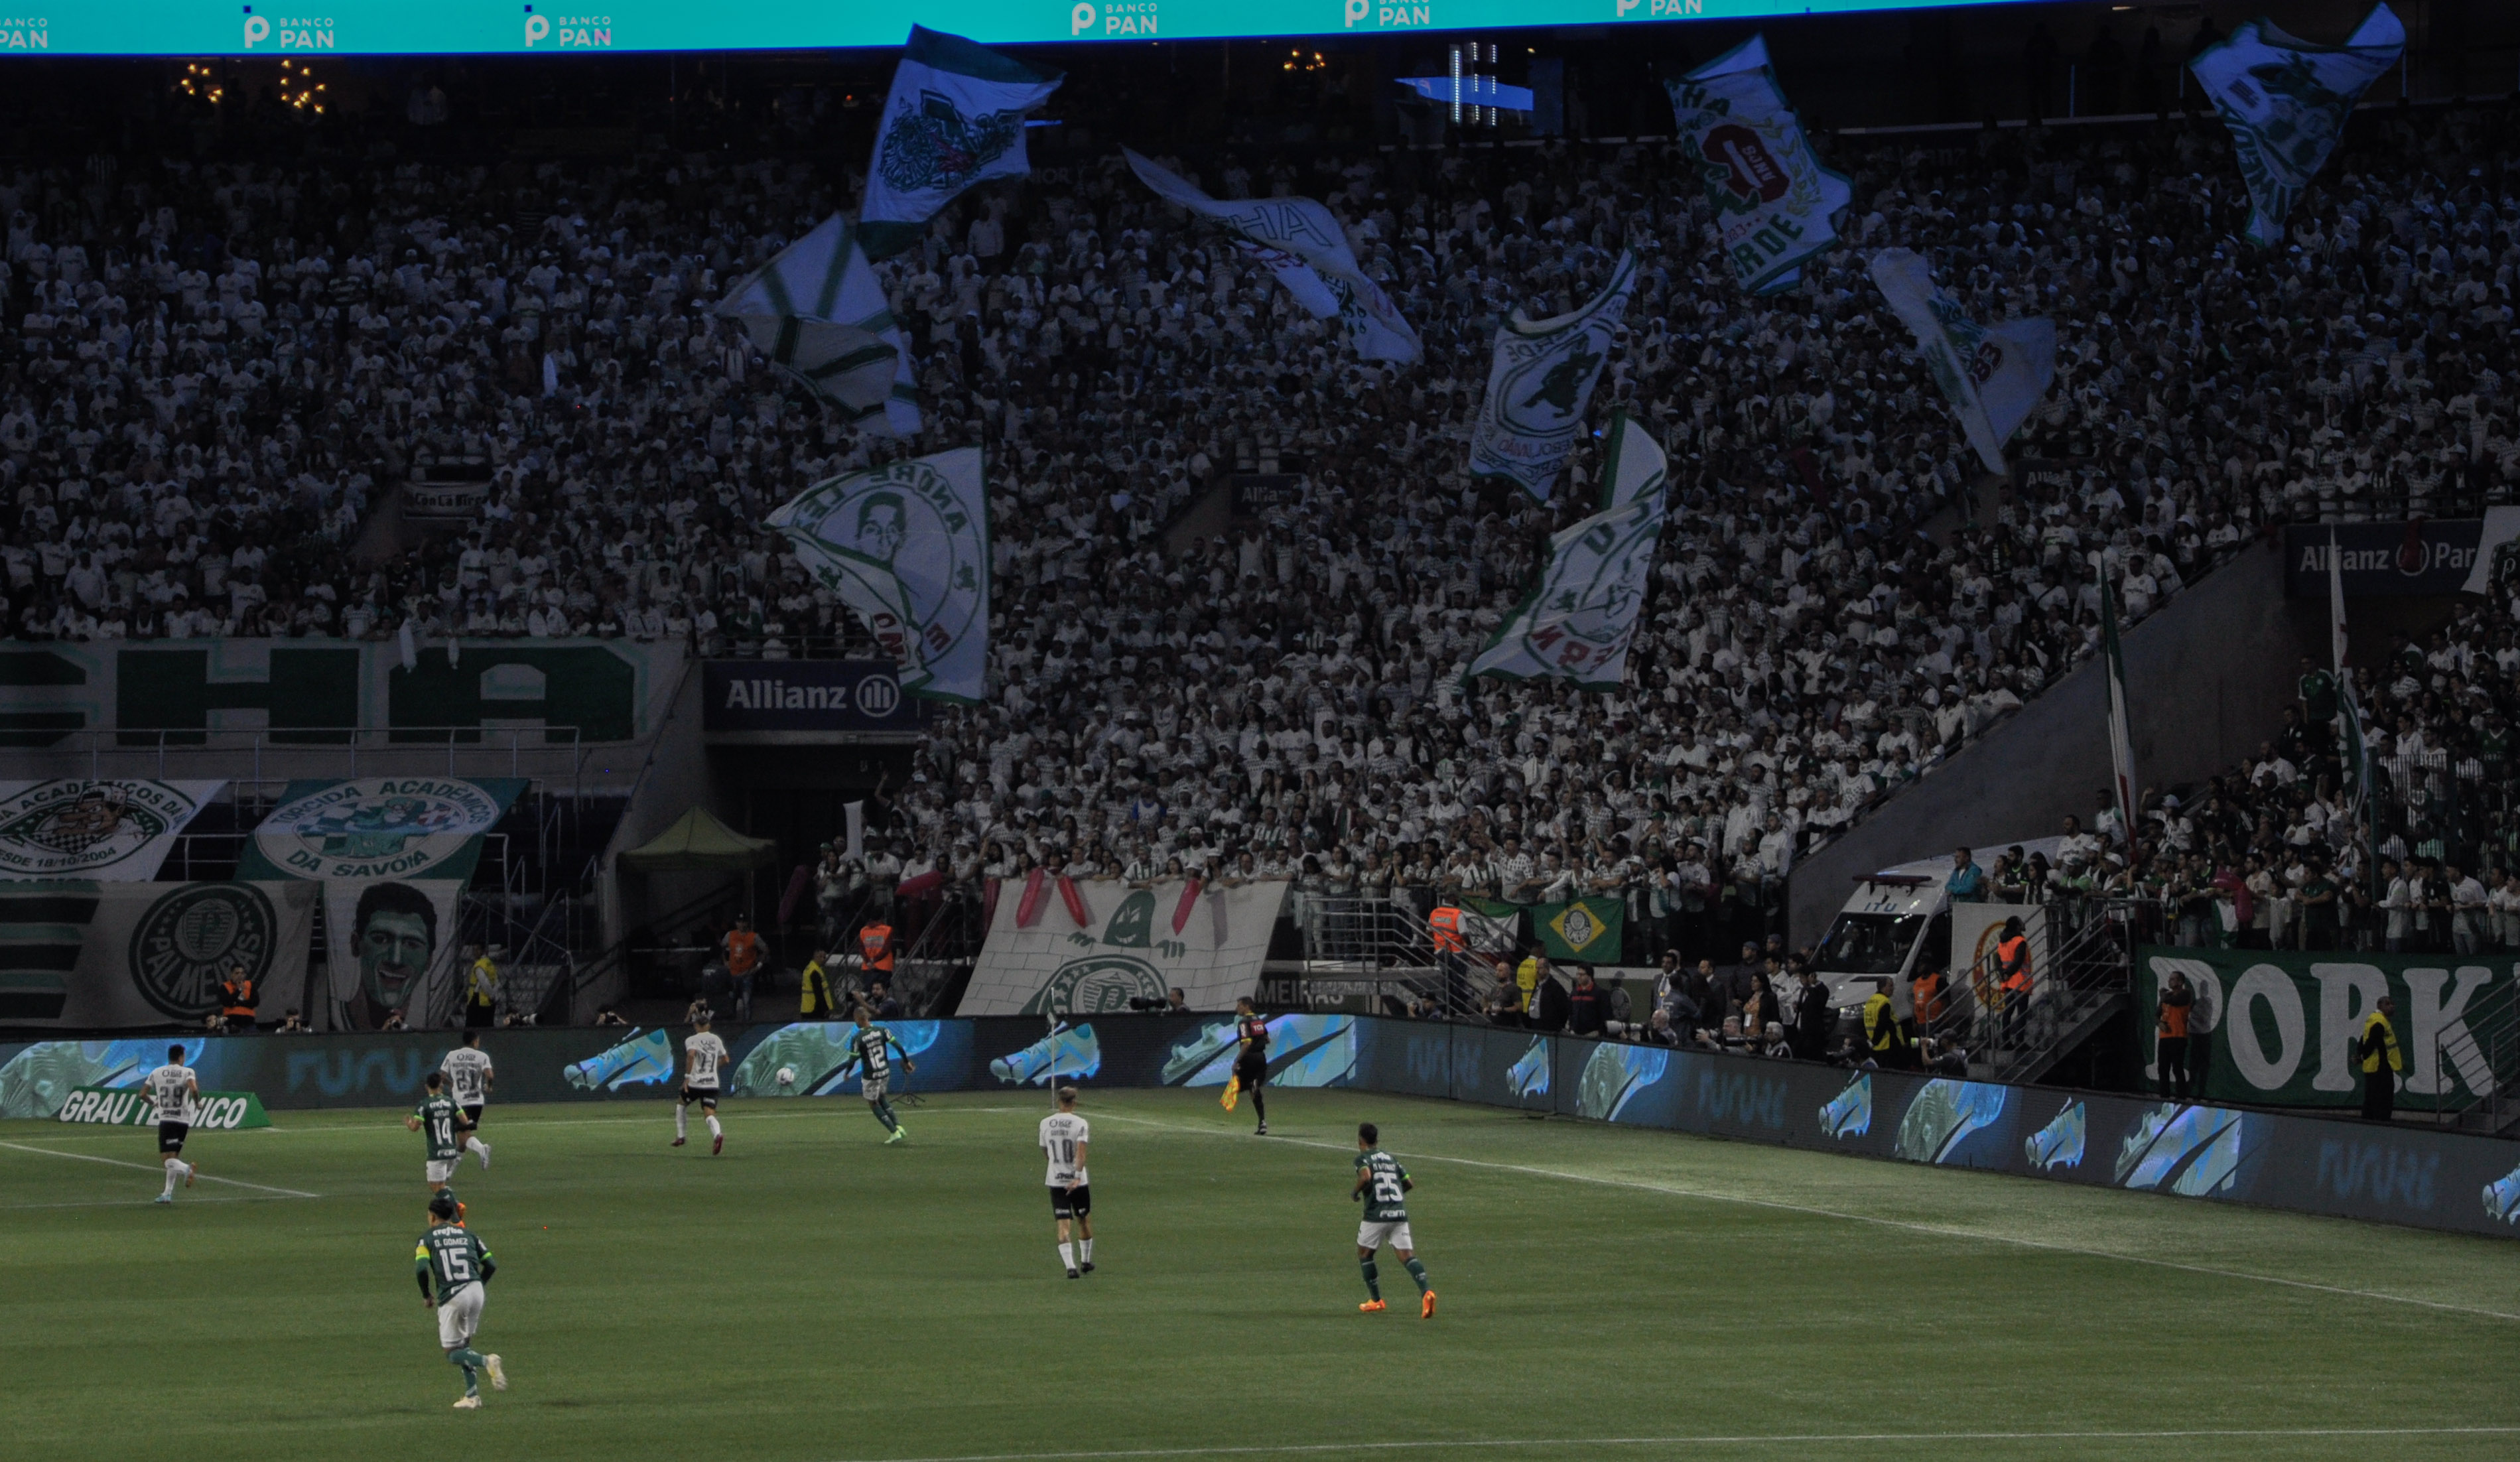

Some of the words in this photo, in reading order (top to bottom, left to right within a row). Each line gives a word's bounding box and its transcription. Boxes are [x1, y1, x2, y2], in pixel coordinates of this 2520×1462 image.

[1105, 3, 1158, 14] BANCO
[1379, 6, 1431, 27] PAN
[1650, 0, 1703, 16] PAN
[0, 18, 48, 27] ANCO
[280, 17, 334, 27] BANCO
[559, 16, 612, 26] BANCO
[1106, 15, 1158, 35] PAN
[280, 30, 334, 48] PAN
[559, 28, 612, 47] PAN
[2434, 542, 2477, 569] Par
[725, 673, 848, 709] Allianz
[271, 785, 364, 824] TORCIDA
[37, 846, 116, 868] 18/10/2004
[286, 849, 323, 872] DA
[867, 1045, 886, 1070] 12
[60, 1090, 137, 1124] GRAU
[160, 1086, 184, 1108] 29
[432, 1117, 453, 1146] 14
[1049, 1138, 1074, 1164] 10
[1372, 1171, 1404, 1202] 25
[438, 1247, 470, 1282] 15
